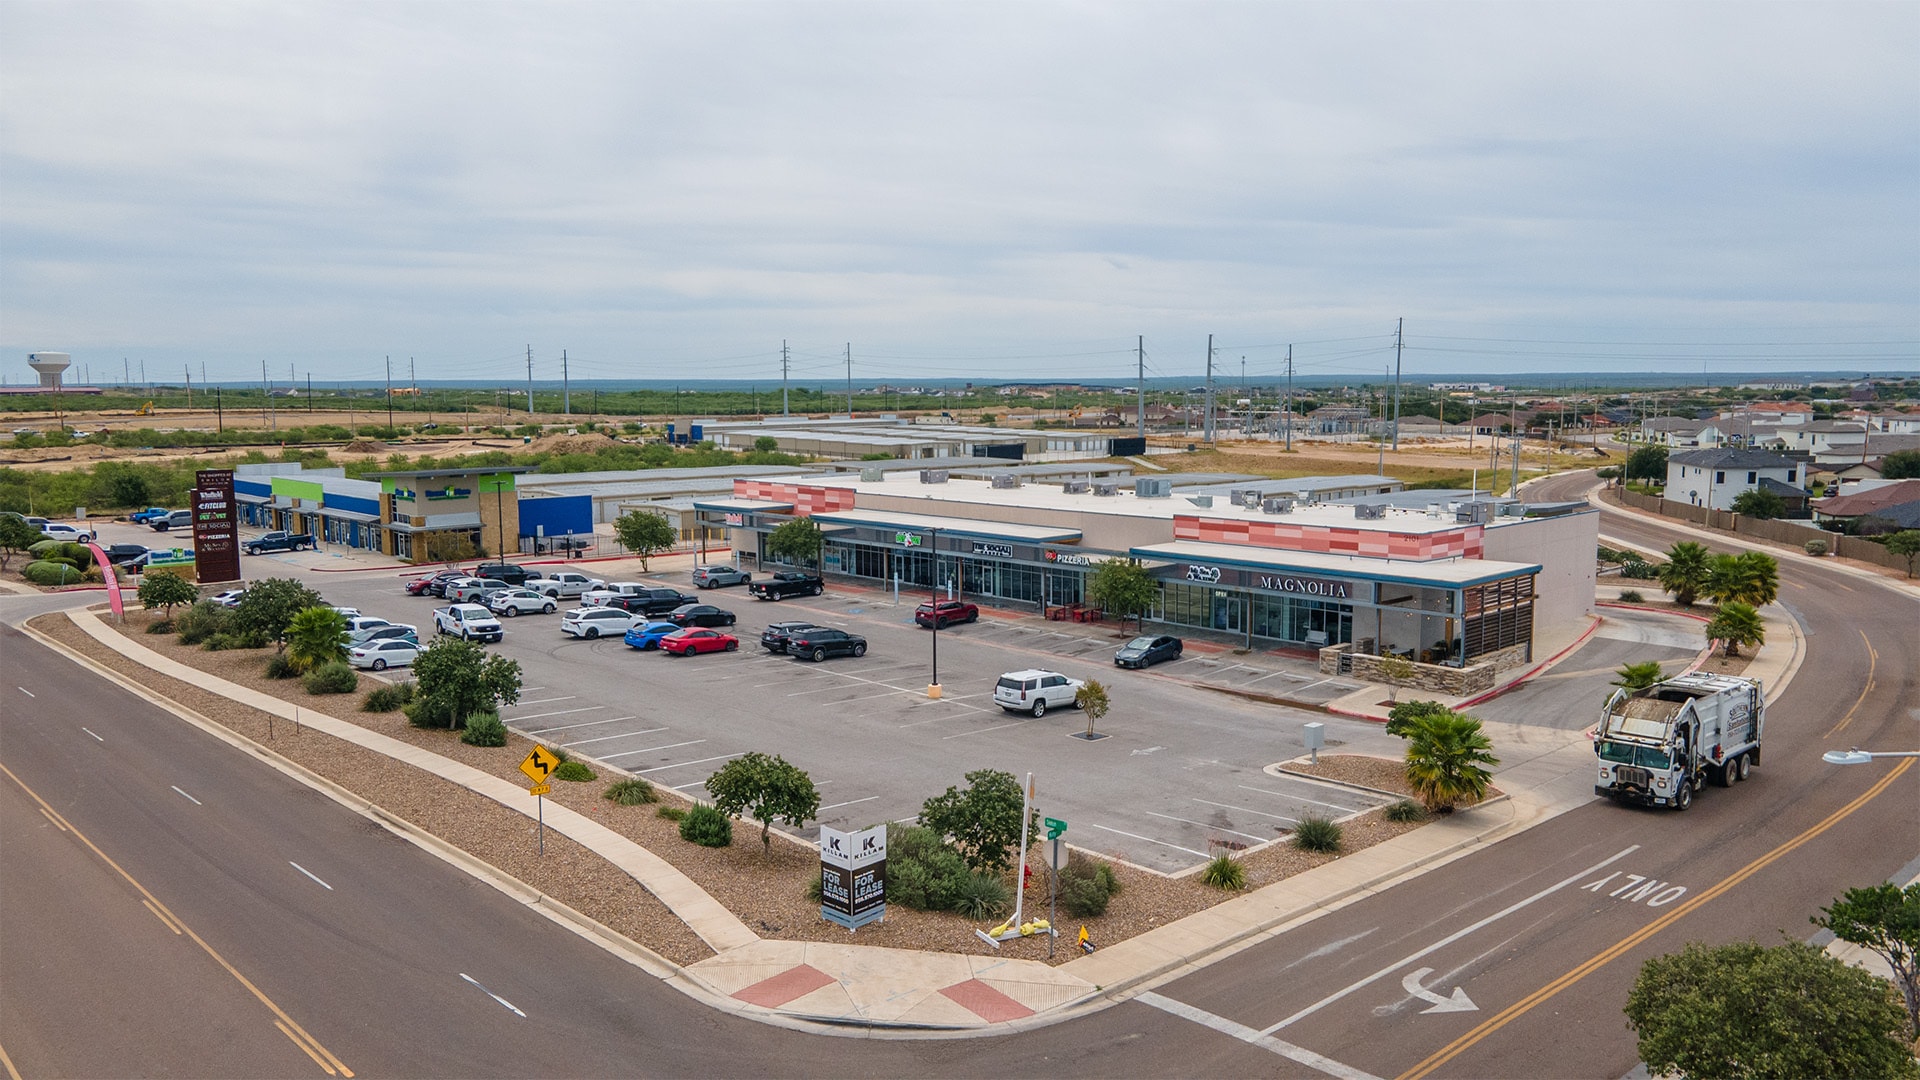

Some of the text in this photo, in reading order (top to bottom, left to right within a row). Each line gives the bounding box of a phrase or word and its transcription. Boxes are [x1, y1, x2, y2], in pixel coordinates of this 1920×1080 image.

[1057, 554, 1091, 566] PIZZERIA
[1261, 576, 1346, 598] MAGNOLIA
[829, 836, 841, 851] K
[863, 836, 875, 851] K
[823, 847, 849, 860] KILLAM
[854, 846, 884, 860] KILLAM
[823, 872, 841, 885] FOR
[855, 874, 874, 889] FOR
[823, 881, 849, 898] LEASE
[855, 880, 883, 899] LEASE
[1580, 871, 1687, 907] ONLY
